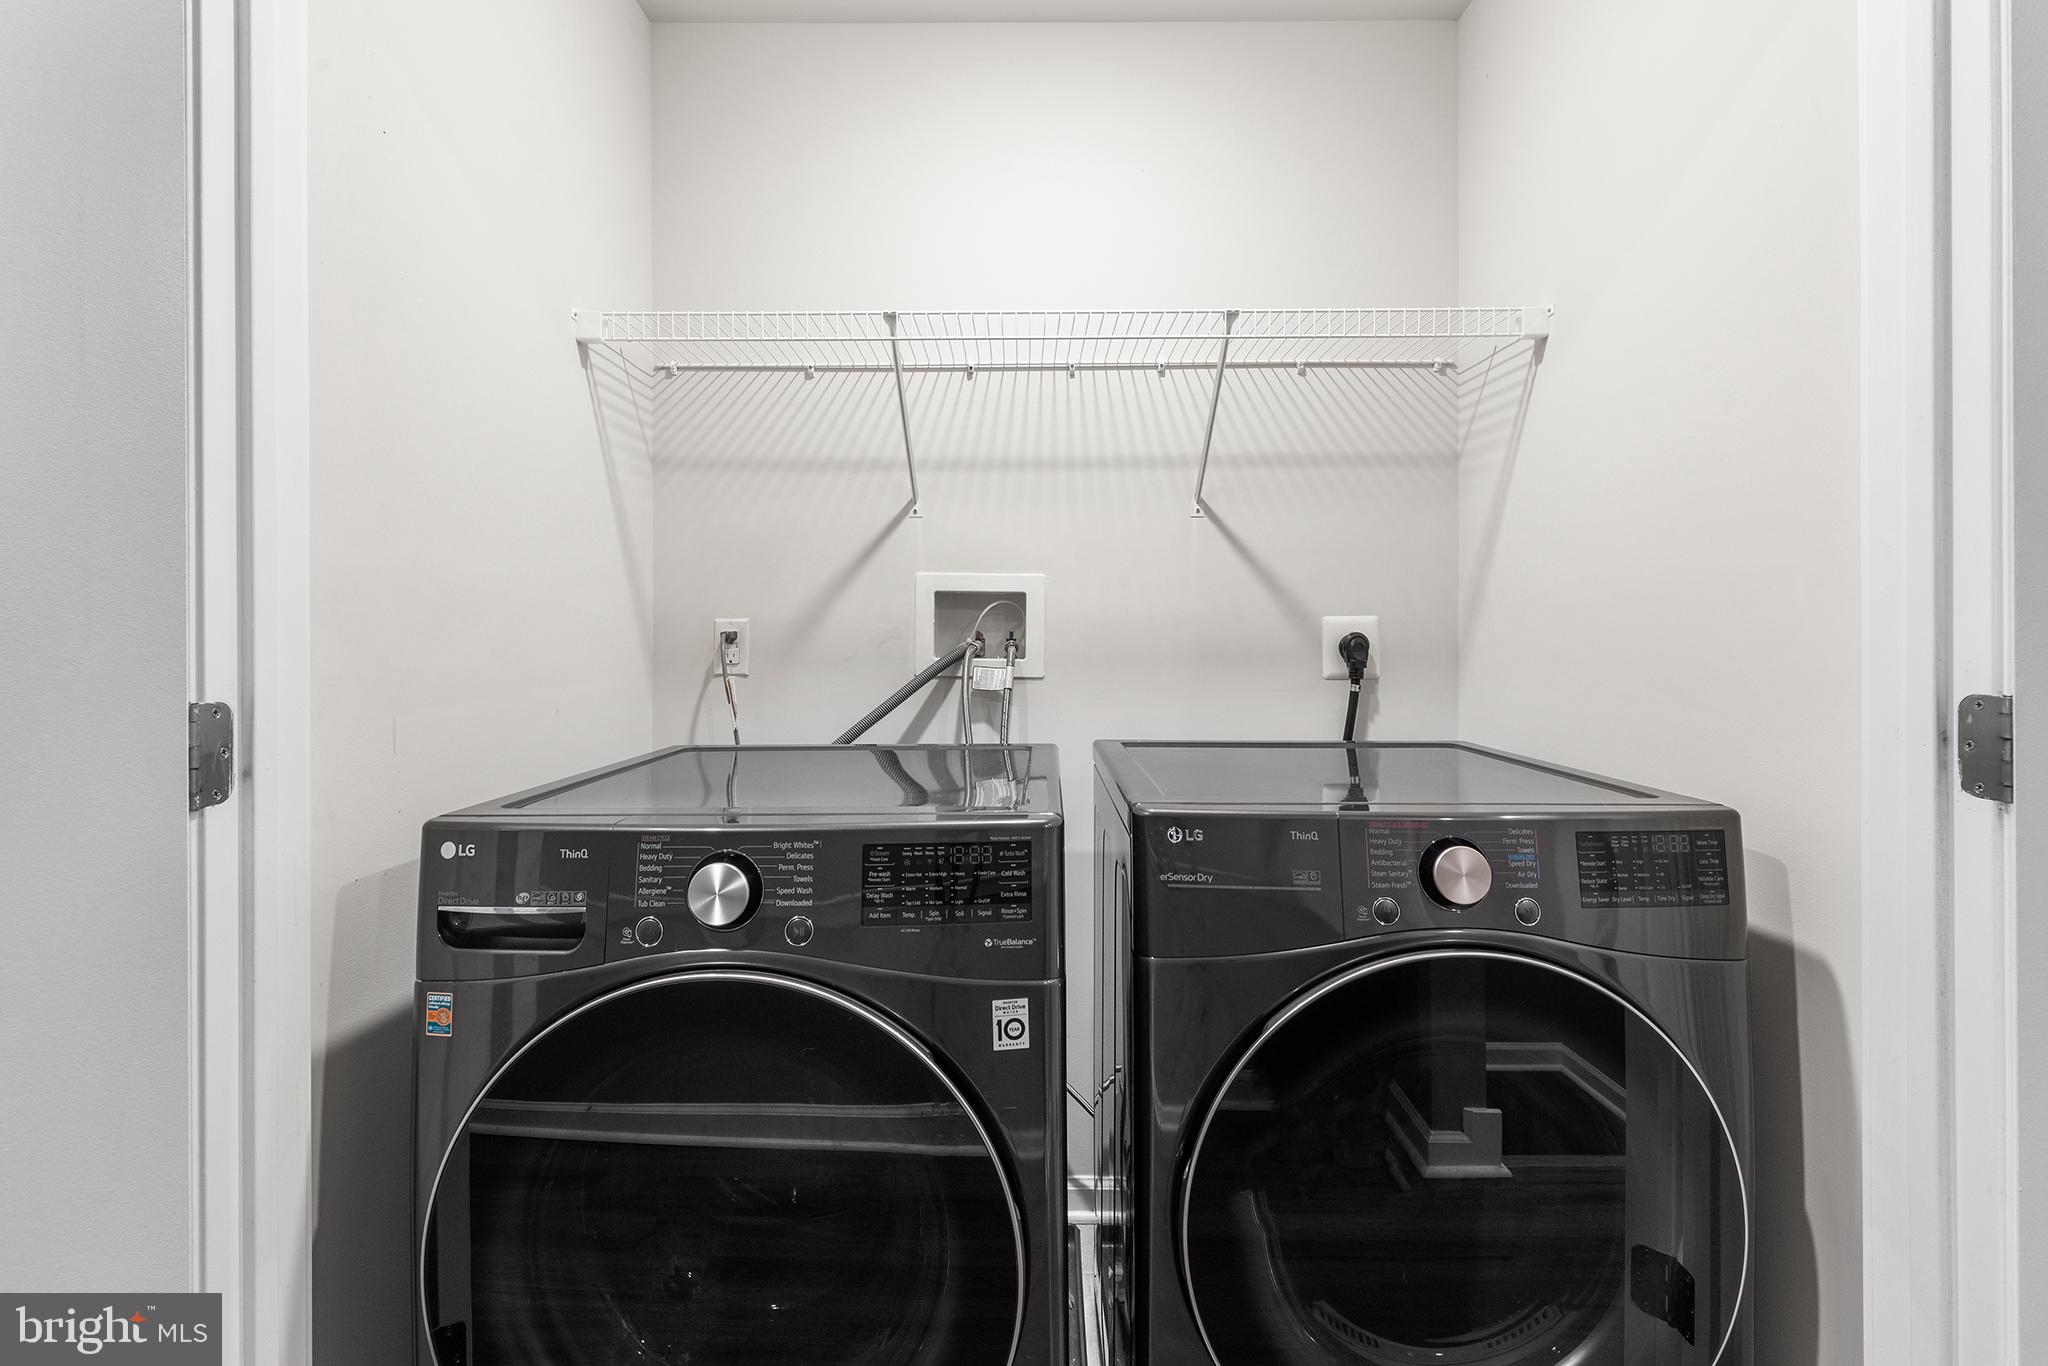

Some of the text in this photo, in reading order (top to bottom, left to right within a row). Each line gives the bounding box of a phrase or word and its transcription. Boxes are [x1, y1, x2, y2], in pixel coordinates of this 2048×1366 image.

[1186, 829, 1204, 841] LG
[1290, 830, 1319, 841] ThinQ
[773, 841, 792, 850] Bright
[1369, 838, 1402, 846] Heavy Duty
[458, 844, 476, 857] LG
[560, 848, 589, 859] ThinQ
[1370, 848, 1393, 857] Bedding
[1517, 846, 1535, 854] Towels
[640, 853, 673, 862] Heavy Duty
[786, 852, 814, 860] Delicates
[639, 864, 663, 873] Bedding
[1508, 860, 1536, 868] Speed Dry
[793, 875, 813, 883] Towels
[1197, 873, 1213, 883] Dry
[1526, 871, 1537, 879] Dry
[638, 876, 663, 884] Sanitary
[776, 887, 793, 896] Speed
[775, 899, 813, 907] Downloaded
[996, 1018, 1025, 1041] 10
